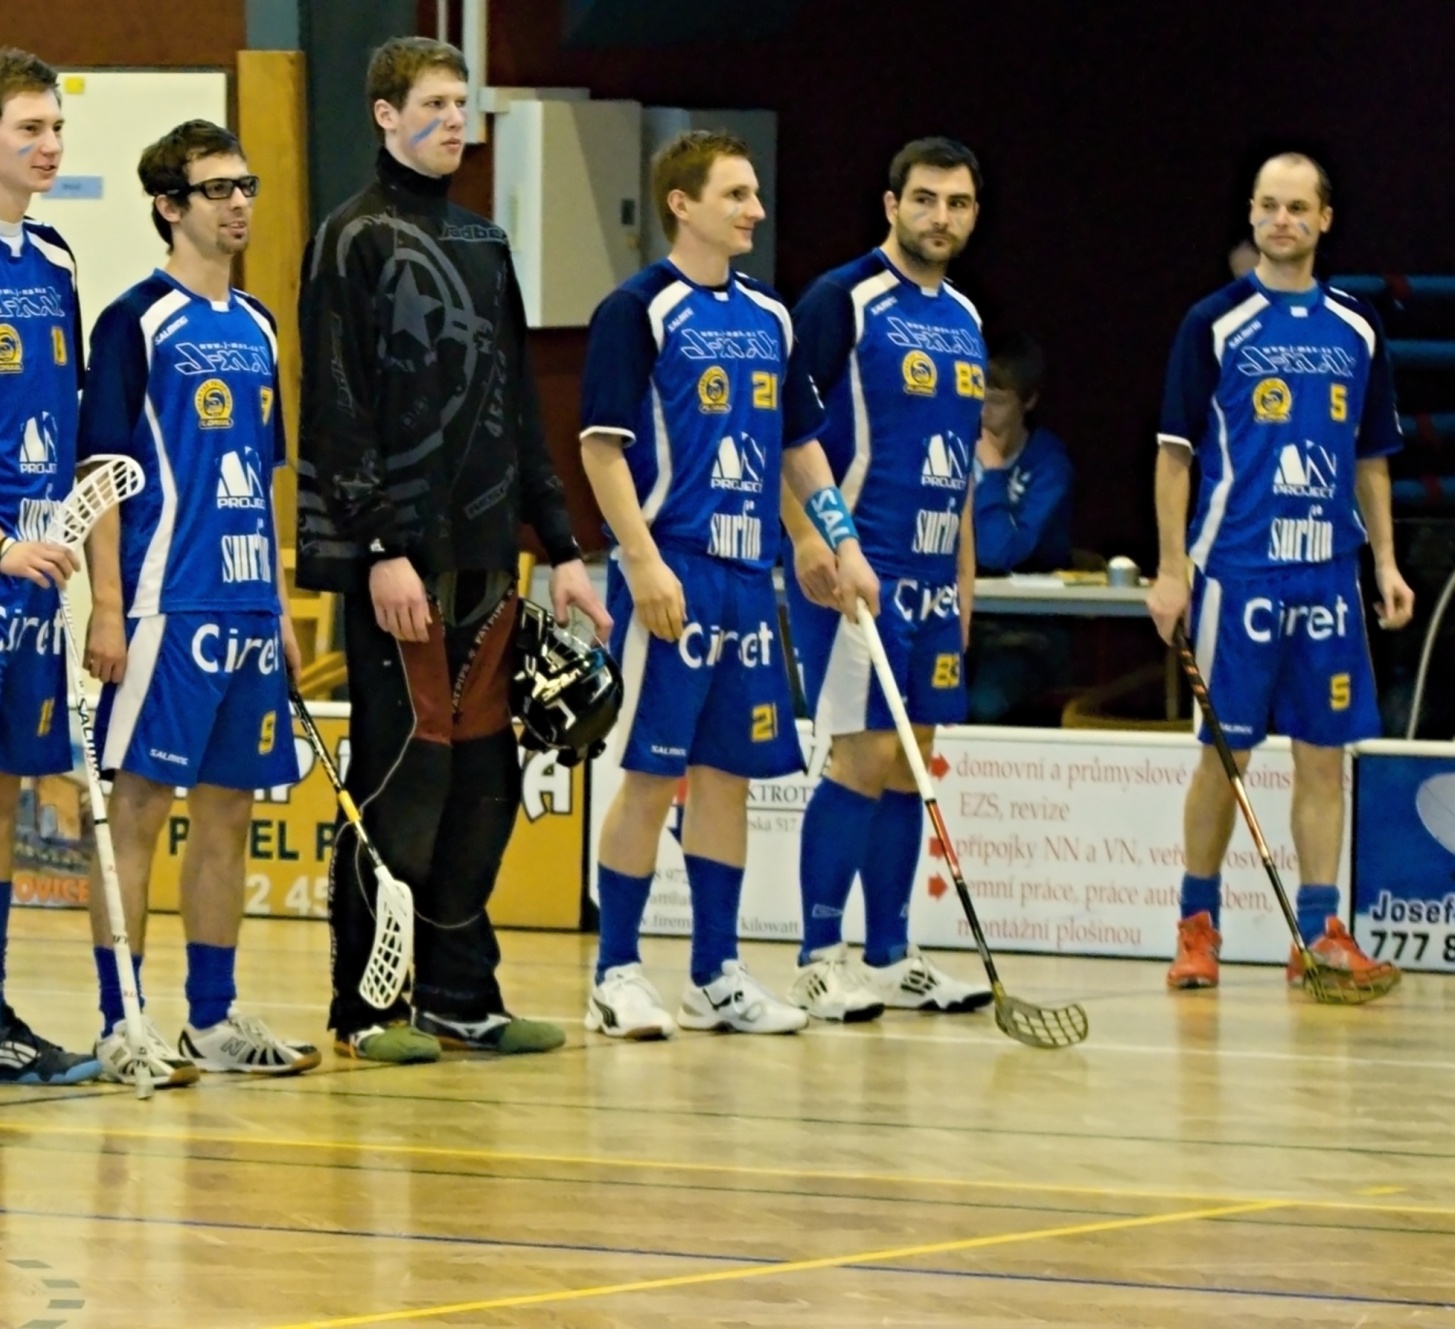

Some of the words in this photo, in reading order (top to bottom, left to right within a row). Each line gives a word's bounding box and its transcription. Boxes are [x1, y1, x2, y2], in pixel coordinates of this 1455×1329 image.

[1330, 383, 1348, 421] 5
[217, 498, 265, 510] PROJEC
[1244, 596, 1348, 642] Ciret
[679, 622, 774, 669] Ciret
[1329, 673, 1351, 710] 5
[1371, 931, 1430, 960] 777
